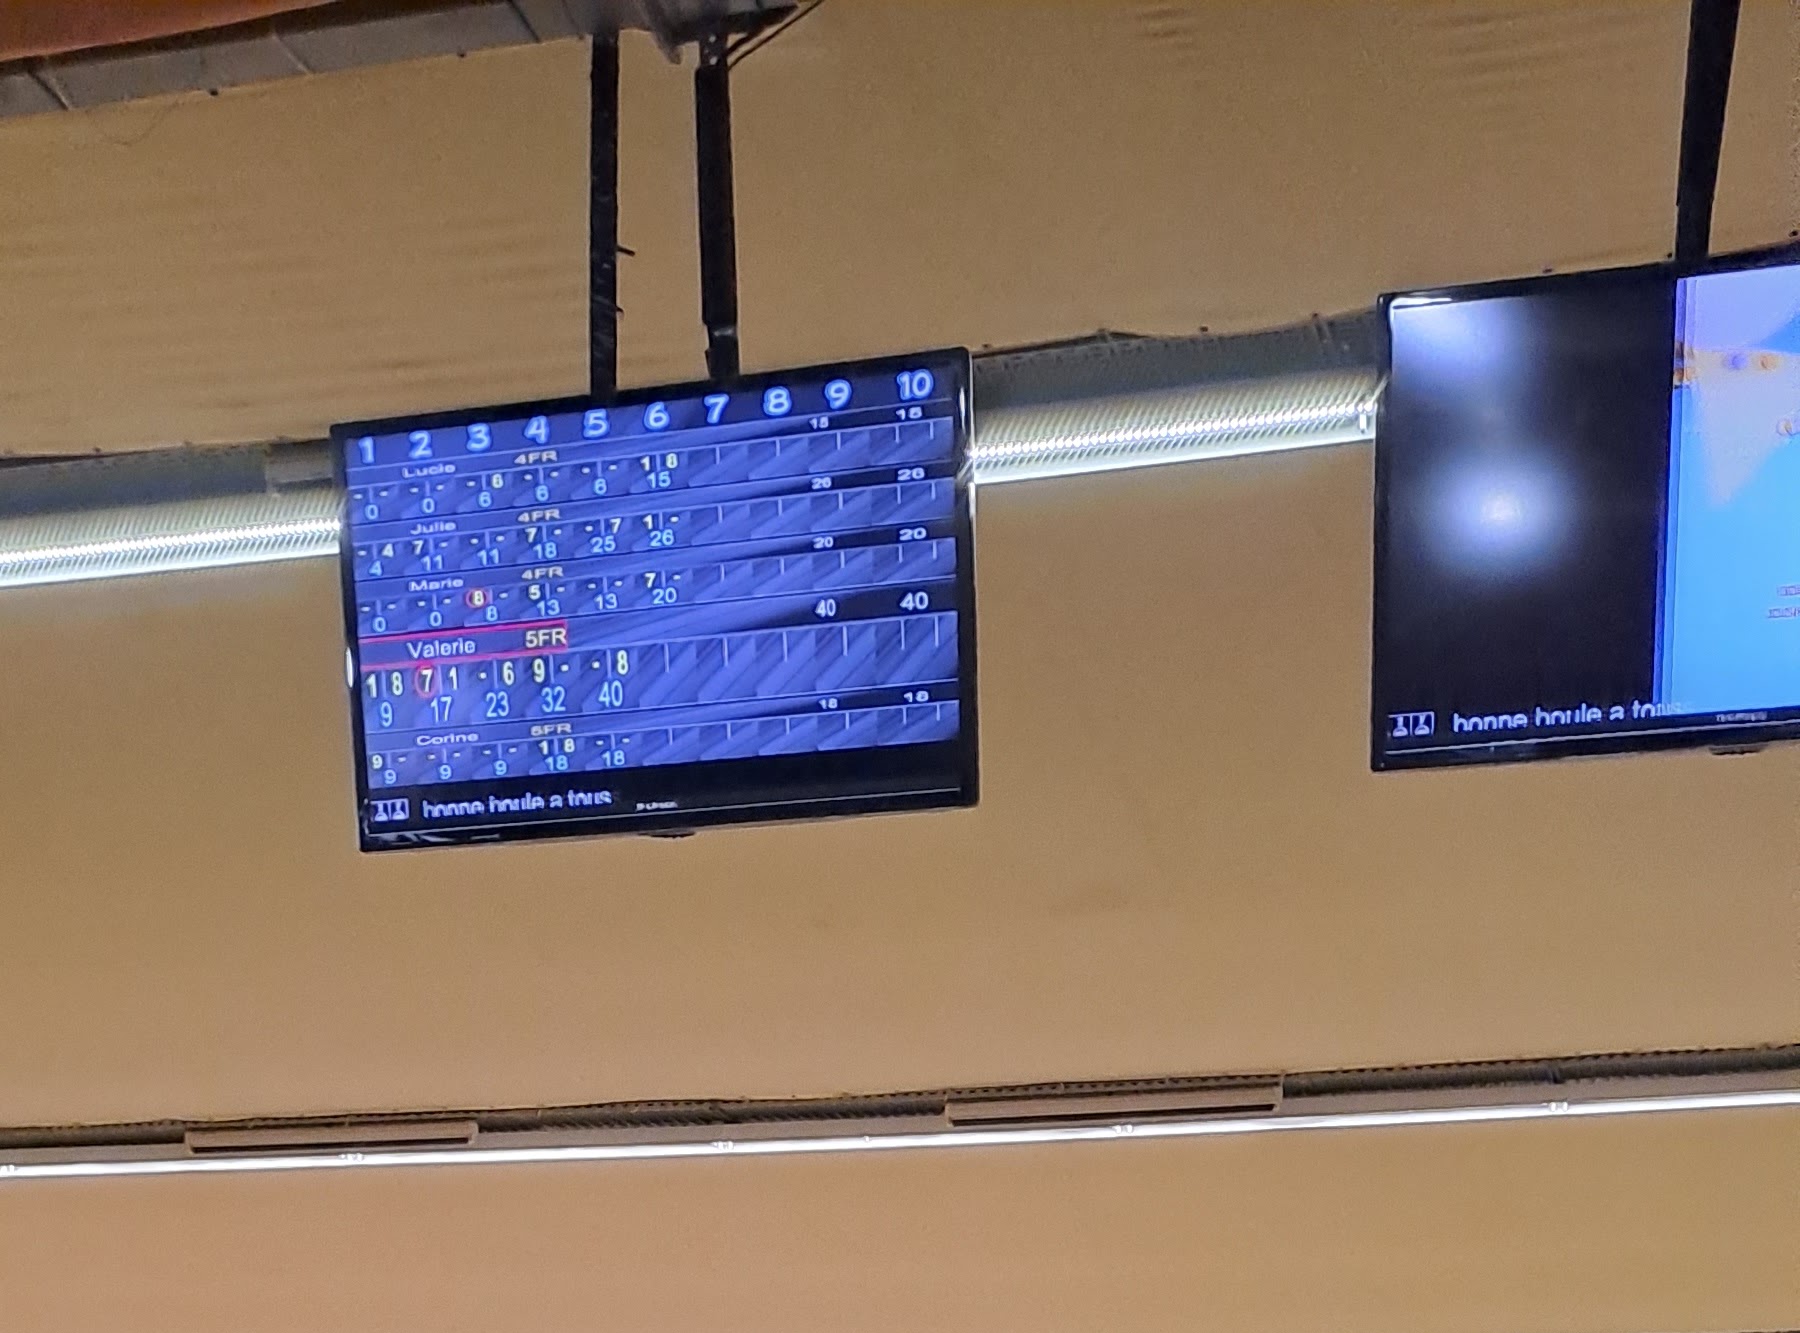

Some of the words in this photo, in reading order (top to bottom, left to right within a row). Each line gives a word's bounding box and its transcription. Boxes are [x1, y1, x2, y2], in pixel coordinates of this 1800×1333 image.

[358, 437, 375, 463] 1
[409, 431, 433, 458] 2
[466, 423, 491, 451] 3
[524, 415, 550, 444] 4
[583, 409, 610, 438] 5
[644, 402, 670, 431] 6
[704, 394, 729, 423] 7
[763, 387, 791, 416] 8
[825, 379, 851, 409] 9
[897, 369, 933, 399] 10
[407, 638, 476, 659] Valerie
[525, 628, 567, 648] 5FR
[815, 599, 836, 618] 40
[900, 591, 929, 610] 40
[366, 674, 377, 698] 1
[392, 672, 403, 695] 8
[421, 669, 432, 692] 7
[449, 667, 457, 690] 1
[503, 661, 515, 685] 6
[533, 658, 545, 683] 9
[617, 650, 628, 675] 8
[380, 702, 392, 727] 9
[431, 696, 452, 722] 17
[486, 691, 509, 718] 23
[541, 686, 566, 712] 32
[598, 680, 623, 707] 40
[1609, 705, 1624, 721] a
[550, 794, 563, 809] a
